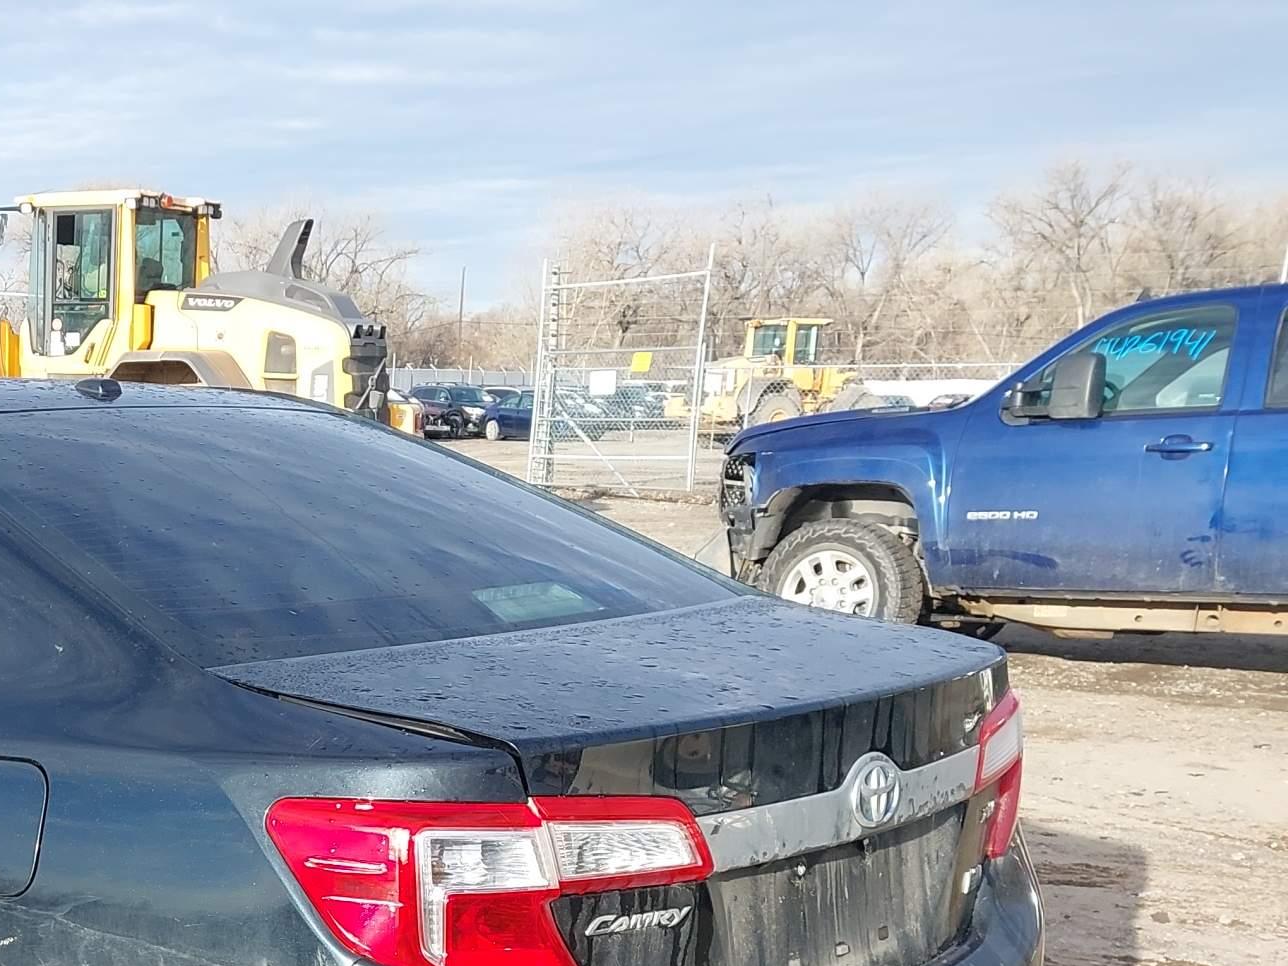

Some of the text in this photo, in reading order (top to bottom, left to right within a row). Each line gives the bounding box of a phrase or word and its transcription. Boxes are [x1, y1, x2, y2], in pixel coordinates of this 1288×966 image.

[188, 297, 234, 308] VOLVO
[1013, 510, 1039, 519] HD
[584, 905, 692, 937] CAMRY
